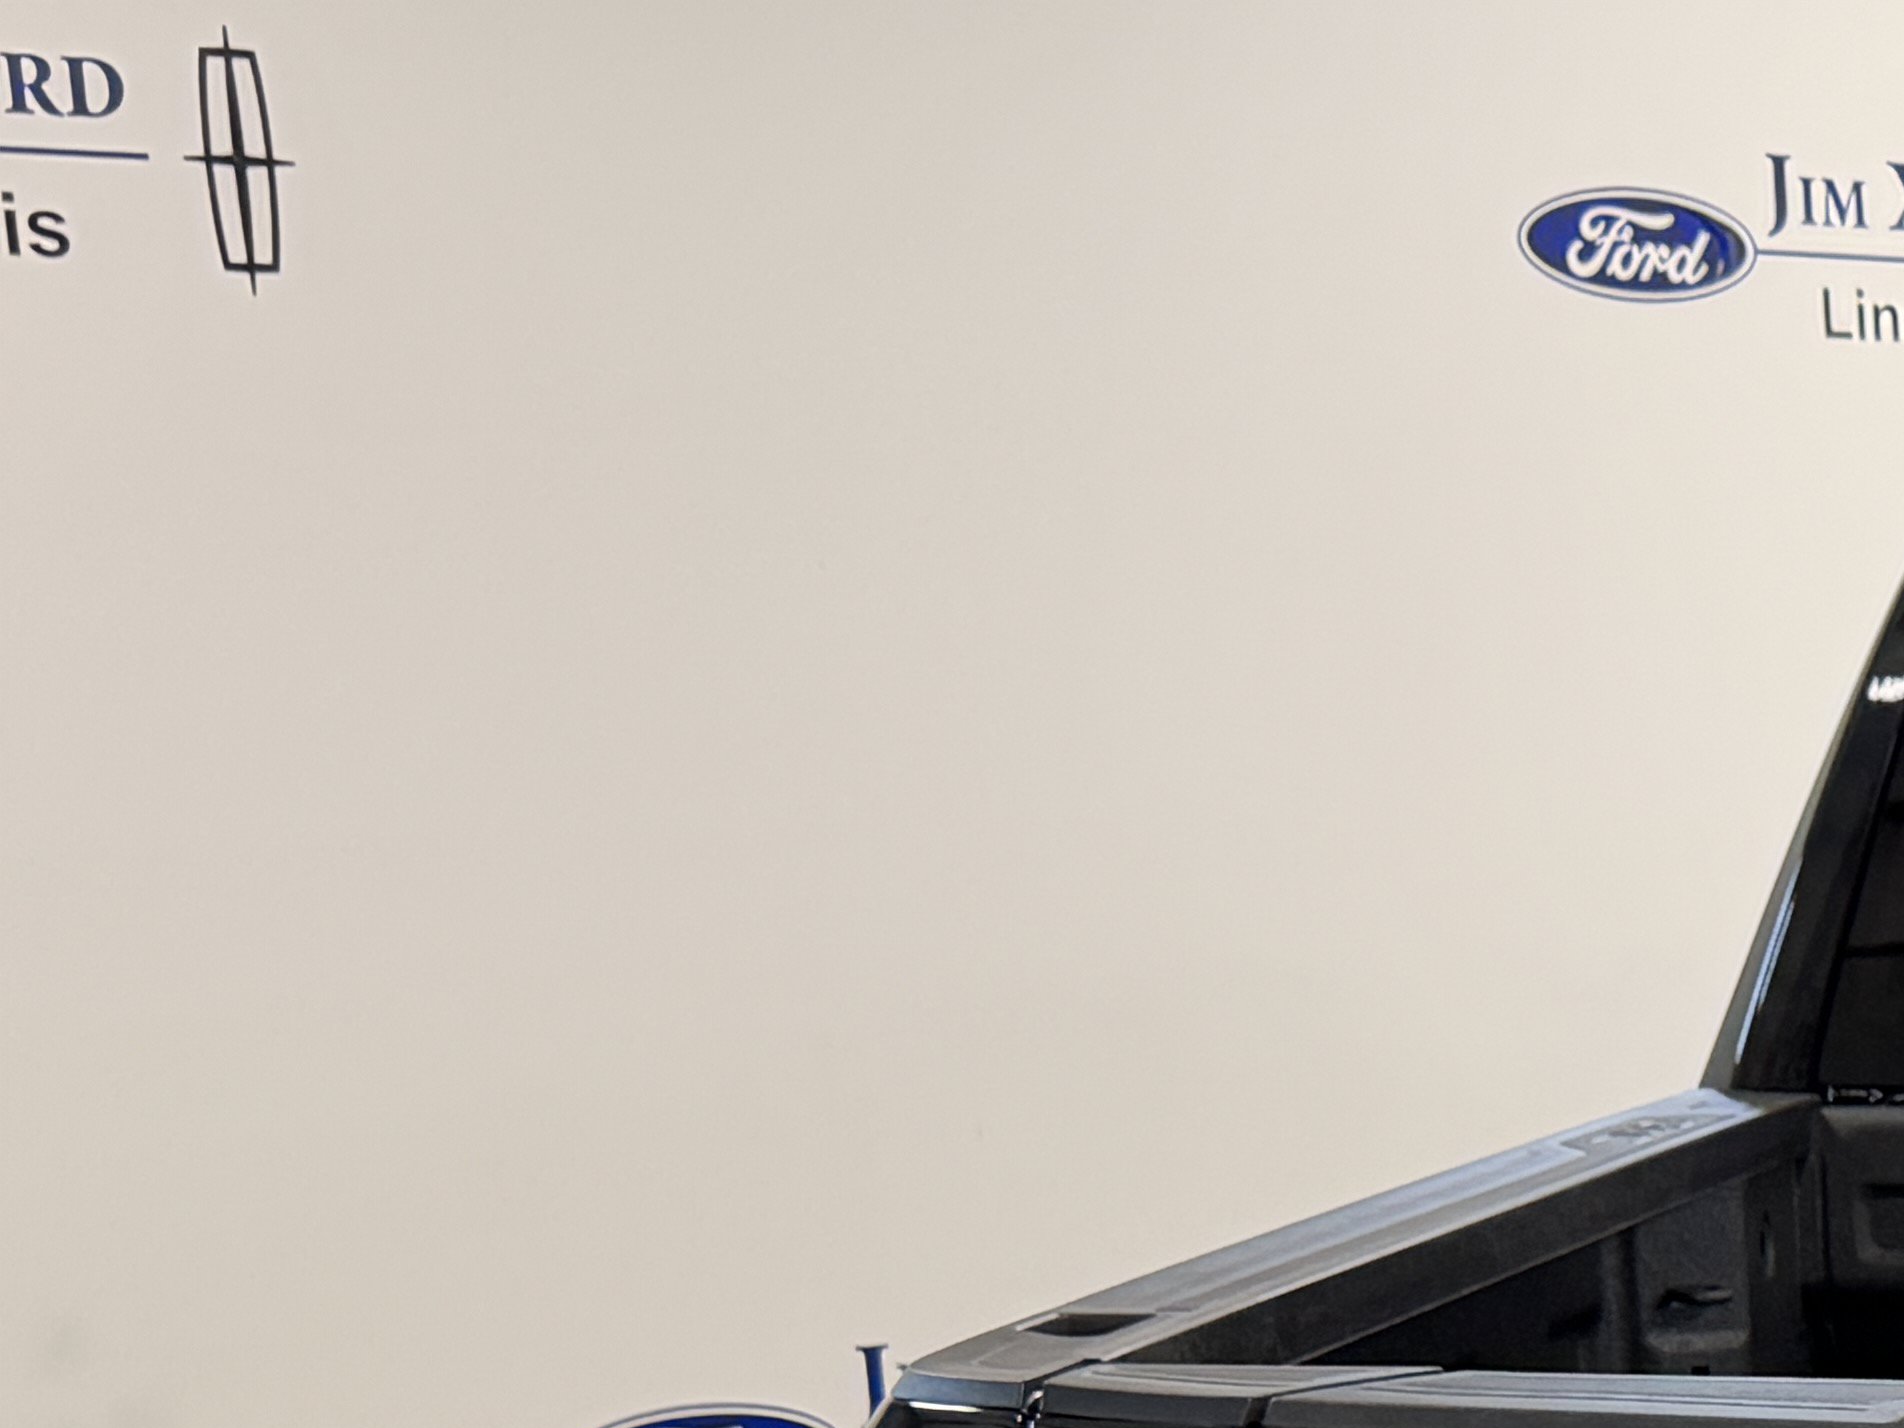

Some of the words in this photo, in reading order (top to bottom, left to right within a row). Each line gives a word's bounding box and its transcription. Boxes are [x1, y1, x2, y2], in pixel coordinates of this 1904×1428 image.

[0, 52, 125, 119] RD
[1765, 152, 1867, 238] JIM
[1566, 204, 1709, 283] Ford
